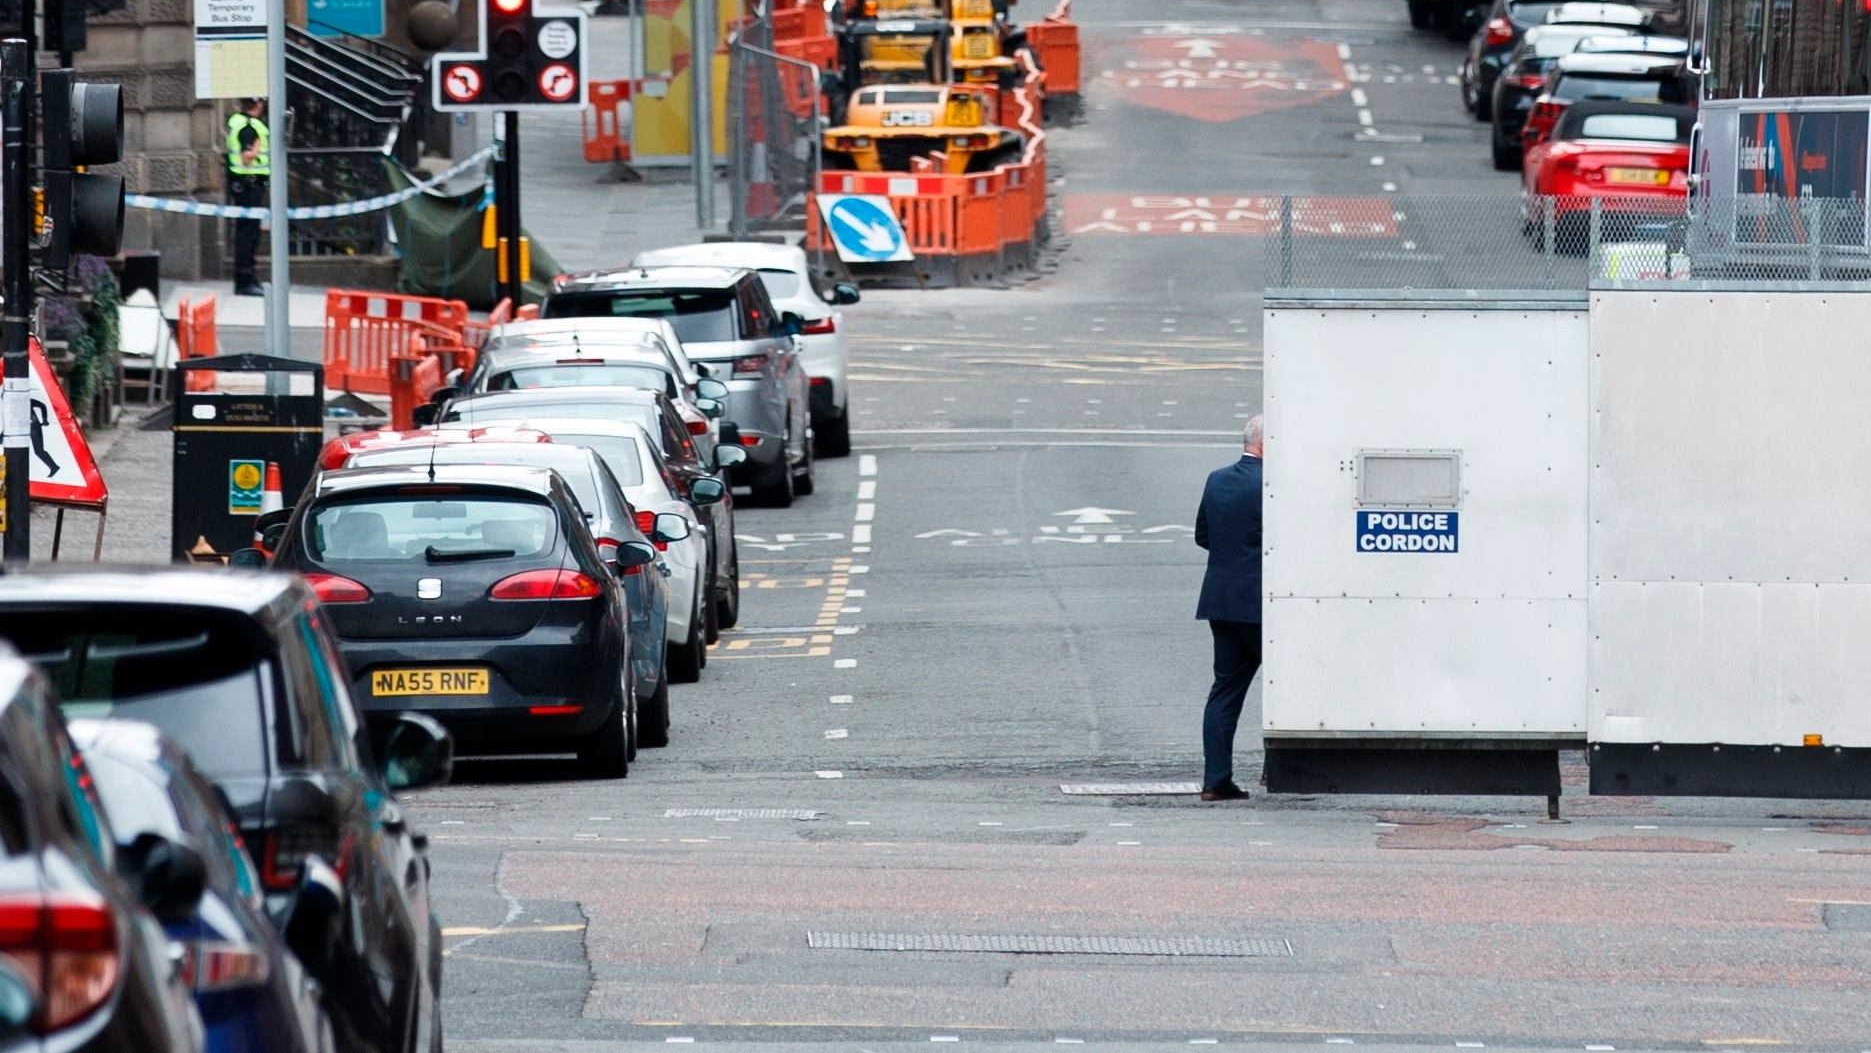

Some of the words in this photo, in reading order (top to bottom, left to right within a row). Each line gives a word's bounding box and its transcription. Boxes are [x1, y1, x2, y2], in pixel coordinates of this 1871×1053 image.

[208, 3, 255, 13] Temporary
[211, 14, 228, 23] Bus
[231, 13, 252, 23] Stop
[882, 112, 934, 127] JCB
[1368, 513, 1449, 530] POLICE
[1360, 534, 1455, 551] CORDON
[398, 615, 462, 624] LEON
[381, 673, 433, 692] NA55
[440, 672, 479, 690] RNF
